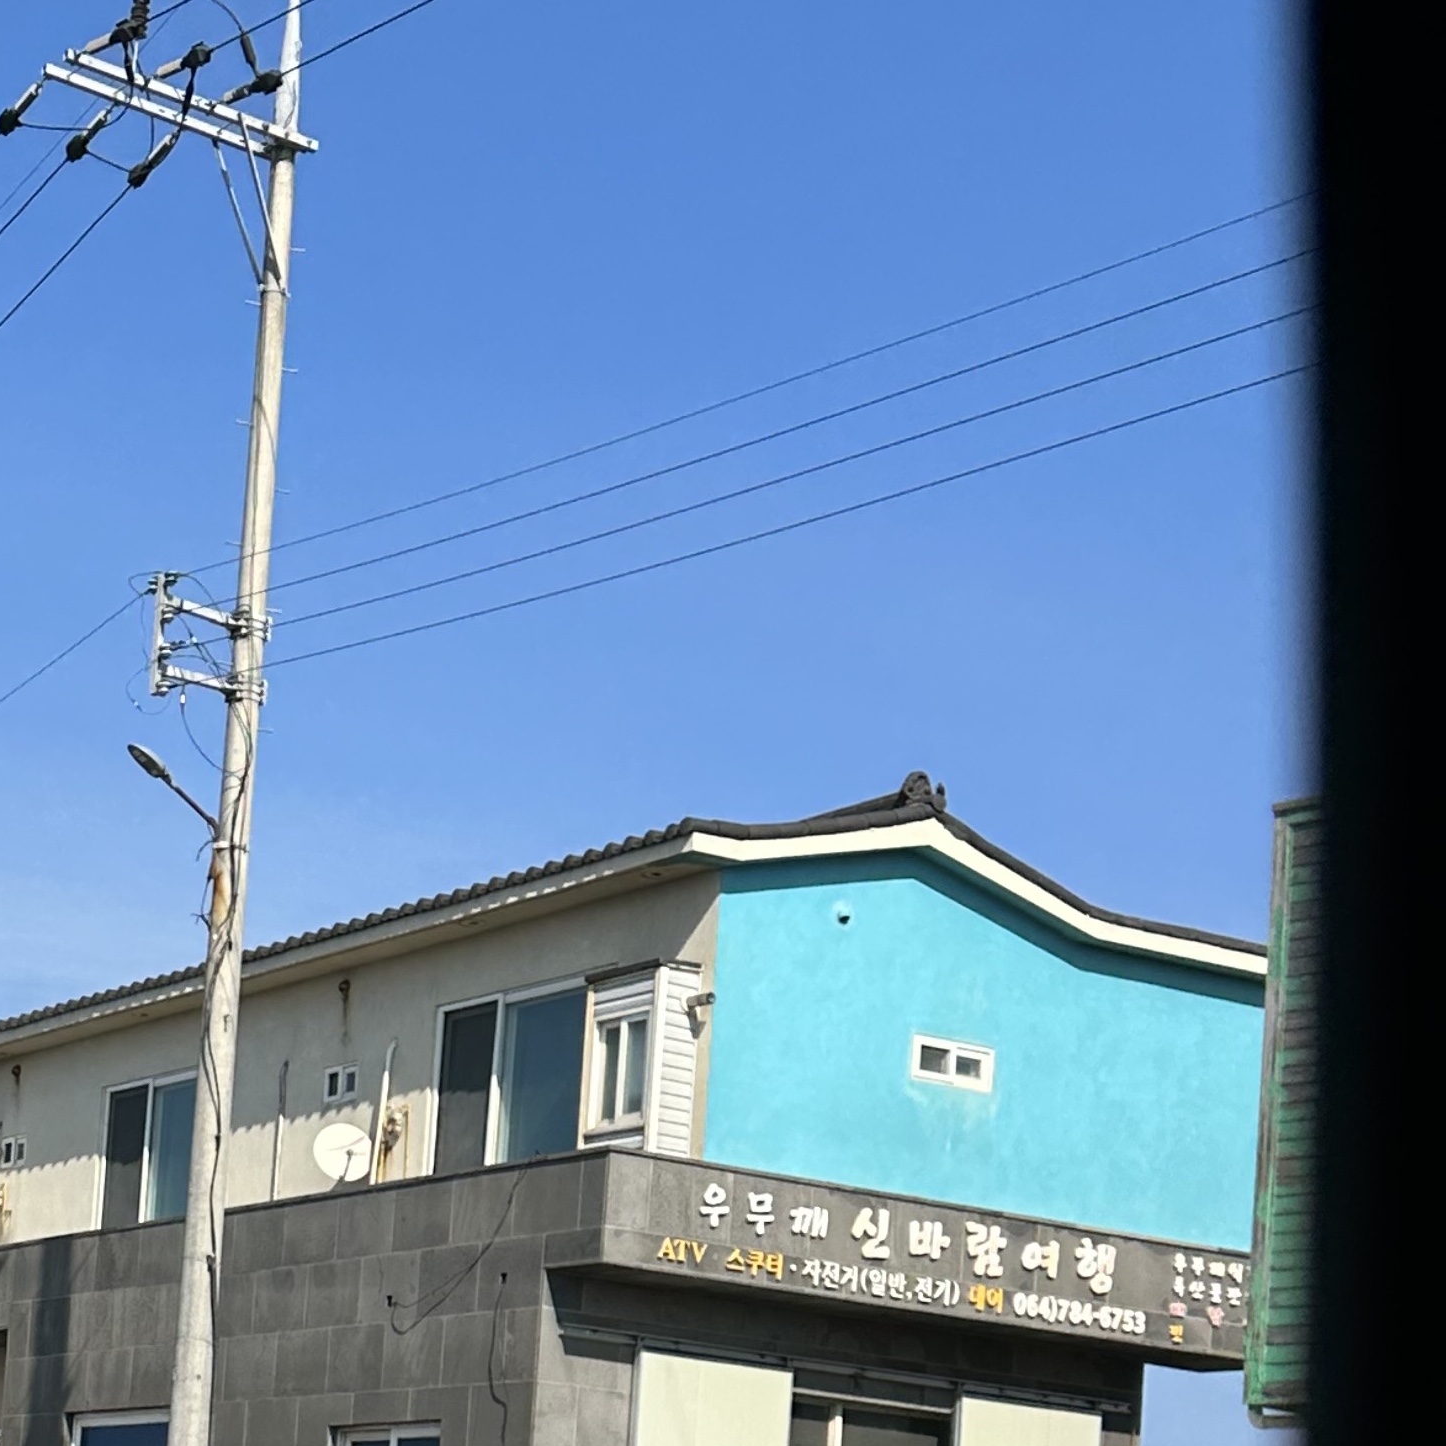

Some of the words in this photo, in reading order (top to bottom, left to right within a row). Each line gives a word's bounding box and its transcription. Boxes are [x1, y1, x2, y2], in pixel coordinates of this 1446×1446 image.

[657, 1237, 708, 1264] ATV
[725, 1248, 784, 1281] 스쿠터
[969, 1283, 1004, 1313] 대여
